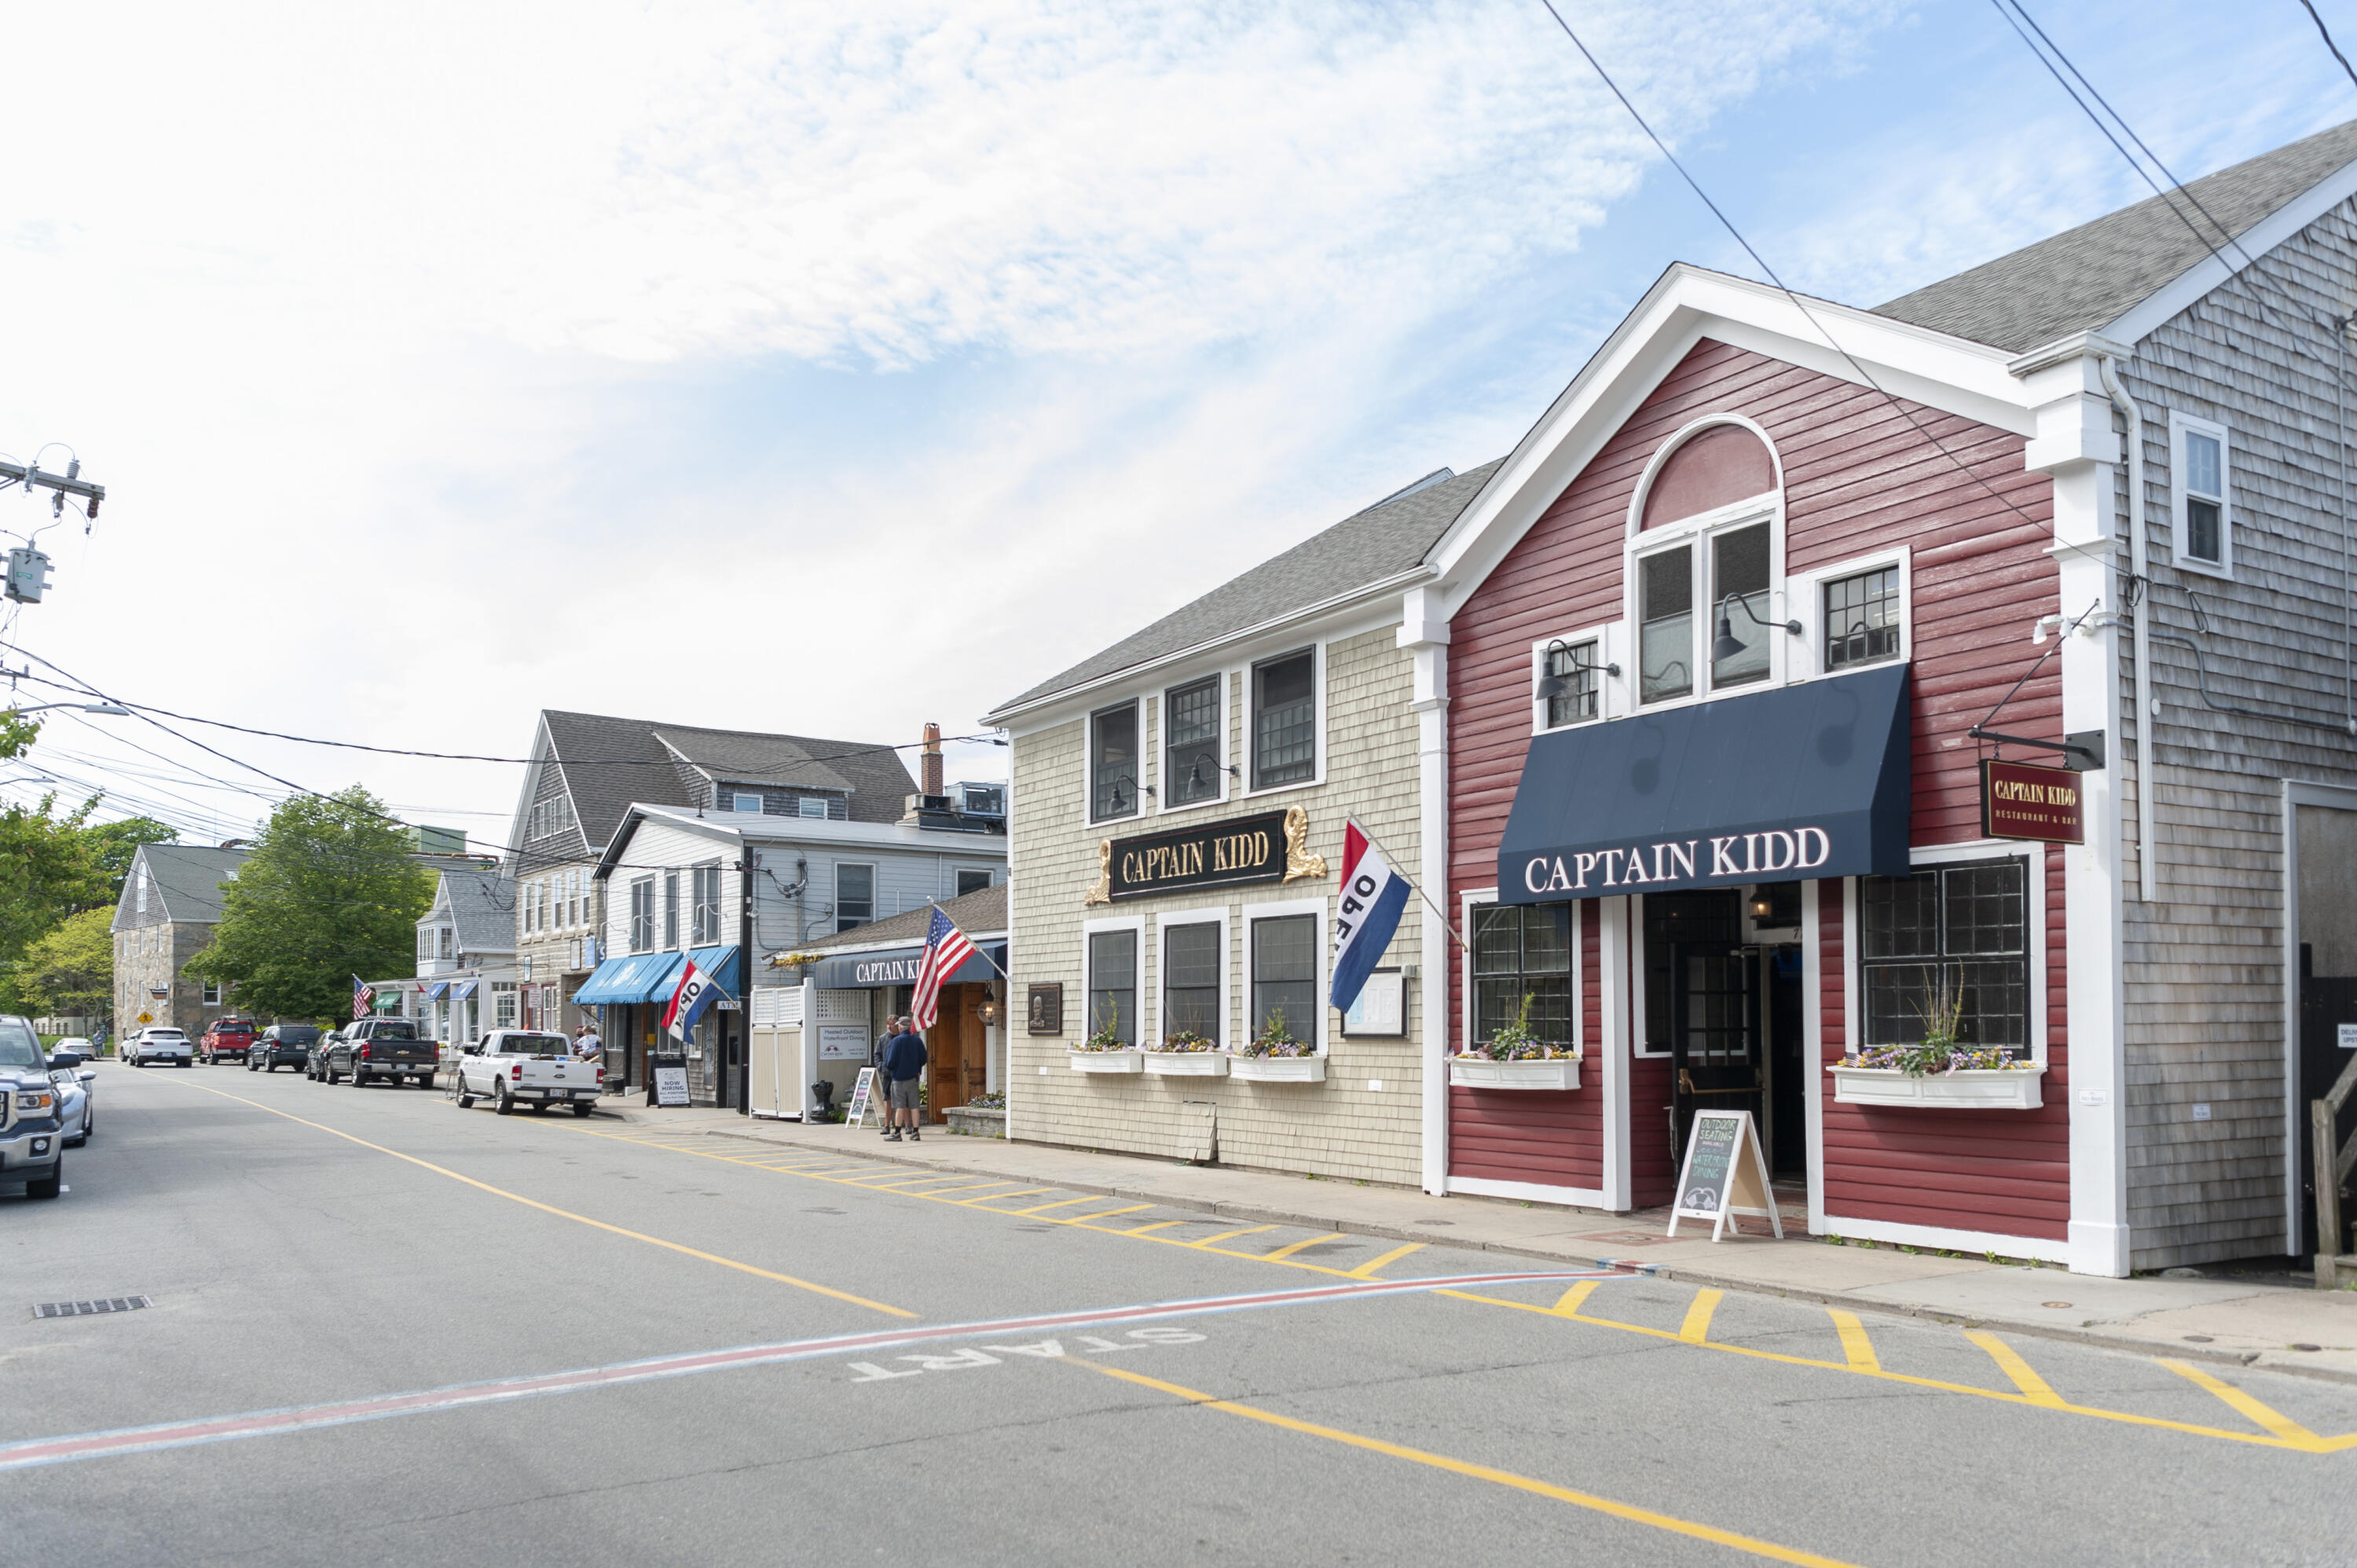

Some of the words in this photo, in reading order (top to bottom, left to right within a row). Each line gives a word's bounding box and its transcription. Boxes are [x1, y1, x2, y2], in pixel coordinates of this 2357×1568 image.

[1995, 780, 2044, 804] CAPTAIN
[2047, 786, 2076, 807] KIDD
[1996, 810, 2048, 822] RESTAURANT
[2053, 815, 2058, 824] &
[2062, 816, 2077, 826] BAR
[1122, 841, 1205, 885] CAPTAIN
[1213, 830, 1270, 872] KIDD
[1525, 840, 1699, 893] CAPTAIN
[1709, 826, 1831, 877] KIDD
[856, 960, 905, 983] CAPTAIN
[907, 958, 923, 980] KI
[1699, 1130, 1733, 1141] SEATING
[1702, 1119, 1736, 1130] OUTDOOR
[1692, 1166, 1719, 1178] DINING
[847, 1327, 1208, 1383] START
